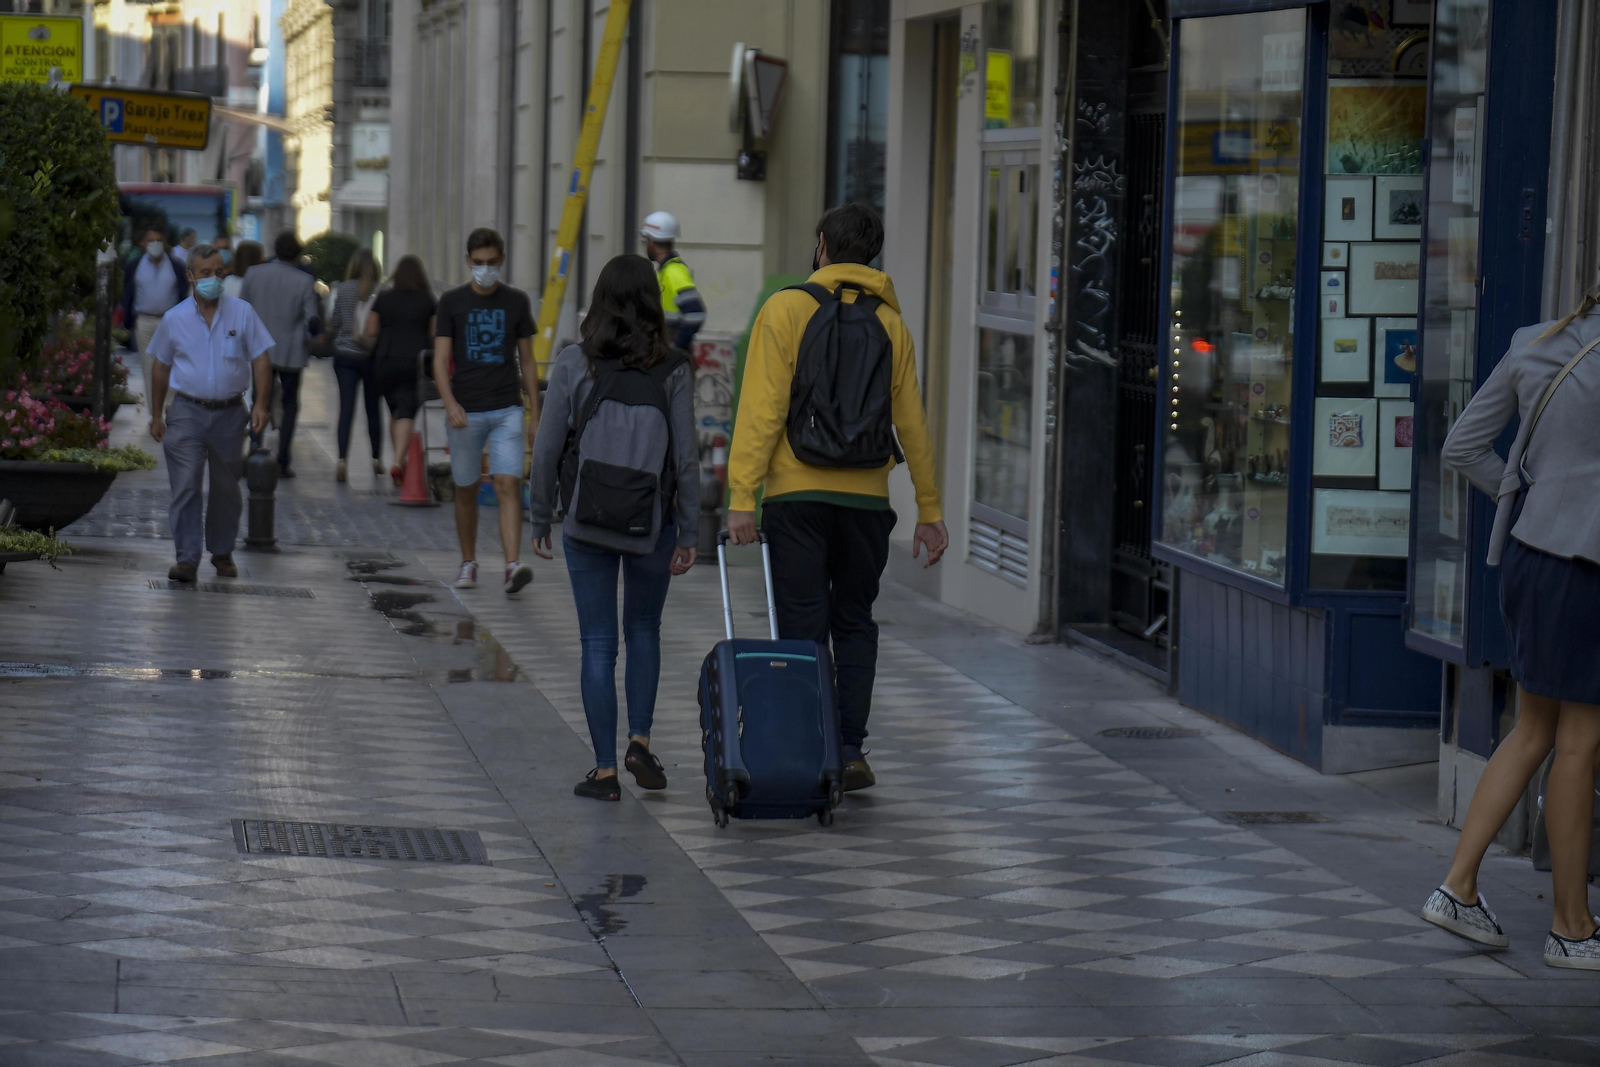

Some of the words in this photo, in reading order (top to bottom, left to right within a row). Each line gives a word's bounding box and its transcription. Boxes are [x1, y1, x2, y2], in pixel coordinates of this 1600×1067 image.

[5, 43, 75, 56] ATENCIÓN
[15, 57, 64, 66] CONTROL
[5, 66, 26, 75] POR
[104, 100, 119, 126] P
[125, 100, 170, 121] Garaje
[174, 104, 205, 122] Trex
[124, 121, 148, 134] Plaza
[149, 124, 165, 136] Los
[167, 125, 204, 140] Campos
